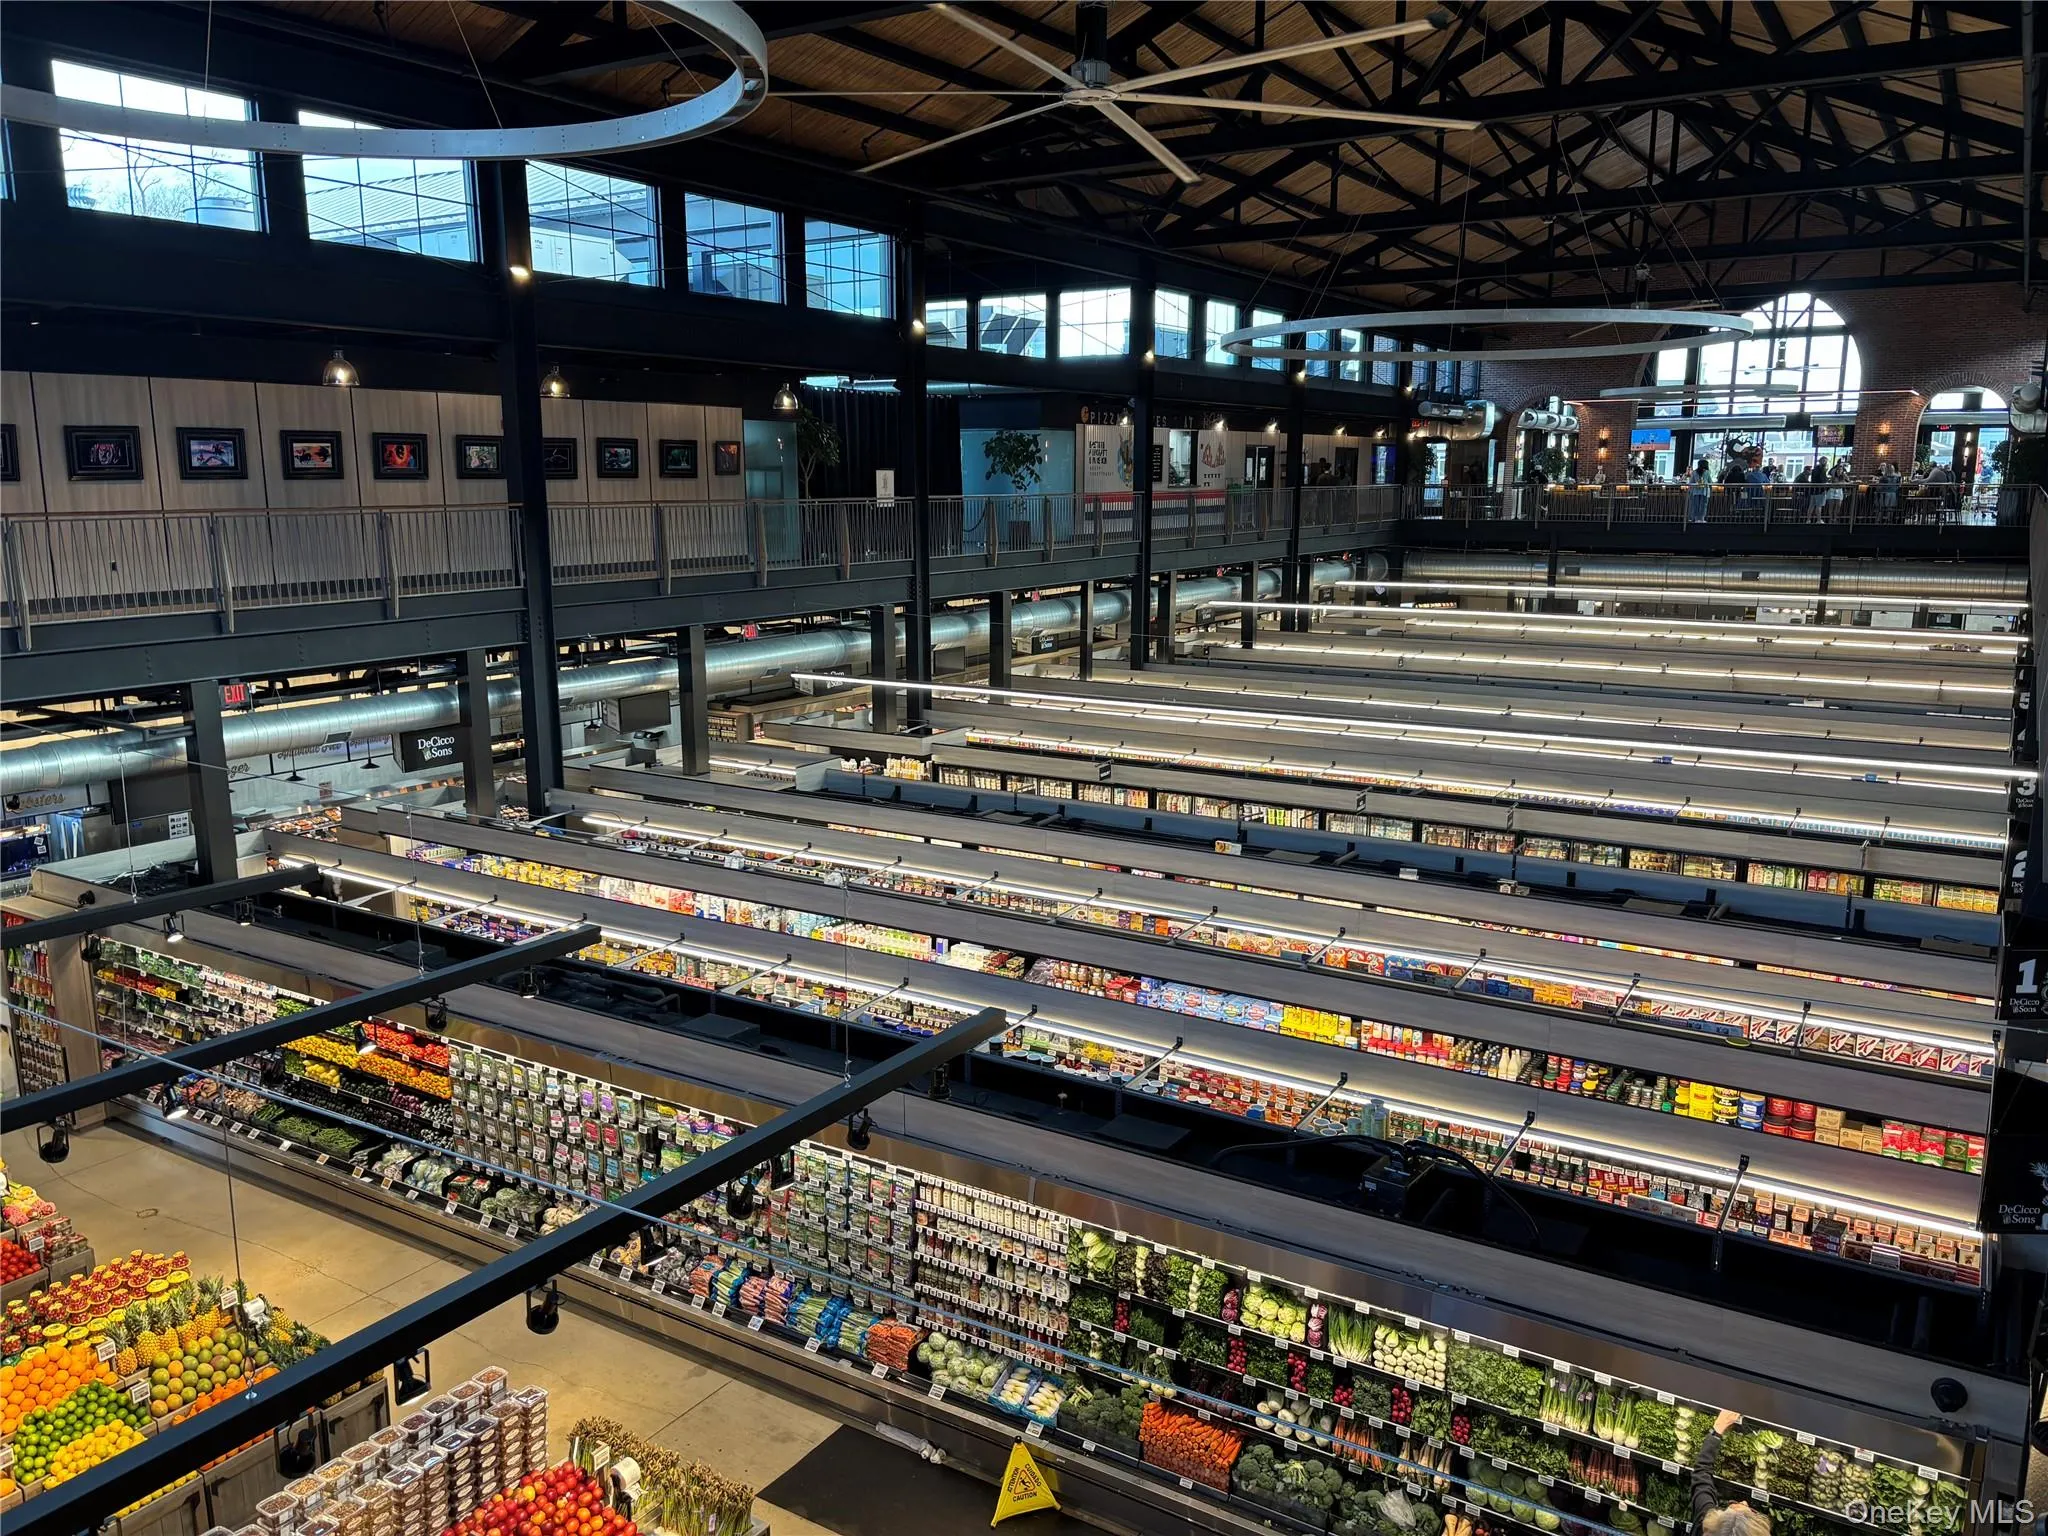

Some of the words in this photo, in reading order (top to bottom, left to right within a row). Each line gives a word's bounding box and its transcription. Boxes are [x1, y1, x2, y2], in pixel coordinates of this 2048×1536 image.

[224, 683, 245, 704] EXIT
[418, 736, 455, 750] DeCicco
[2016, 776, 2036, 796] 3
[2016, 958, 2038, 994] 1
[1830, 1032, 1847, 1047] K
[1857, 1039, 1876, 1054] K
[1884, 1043, 1902, 1058] K
[1912, 1048, 1929, 1063] K
[1942, 1052, 1962, 1068] K
[1998, 1204, 2041, 1214] DeCicco
[1024, 1463, 1042, 1487] CUIDADO
[1012, 1491, 1038, 1503] CAUTION
